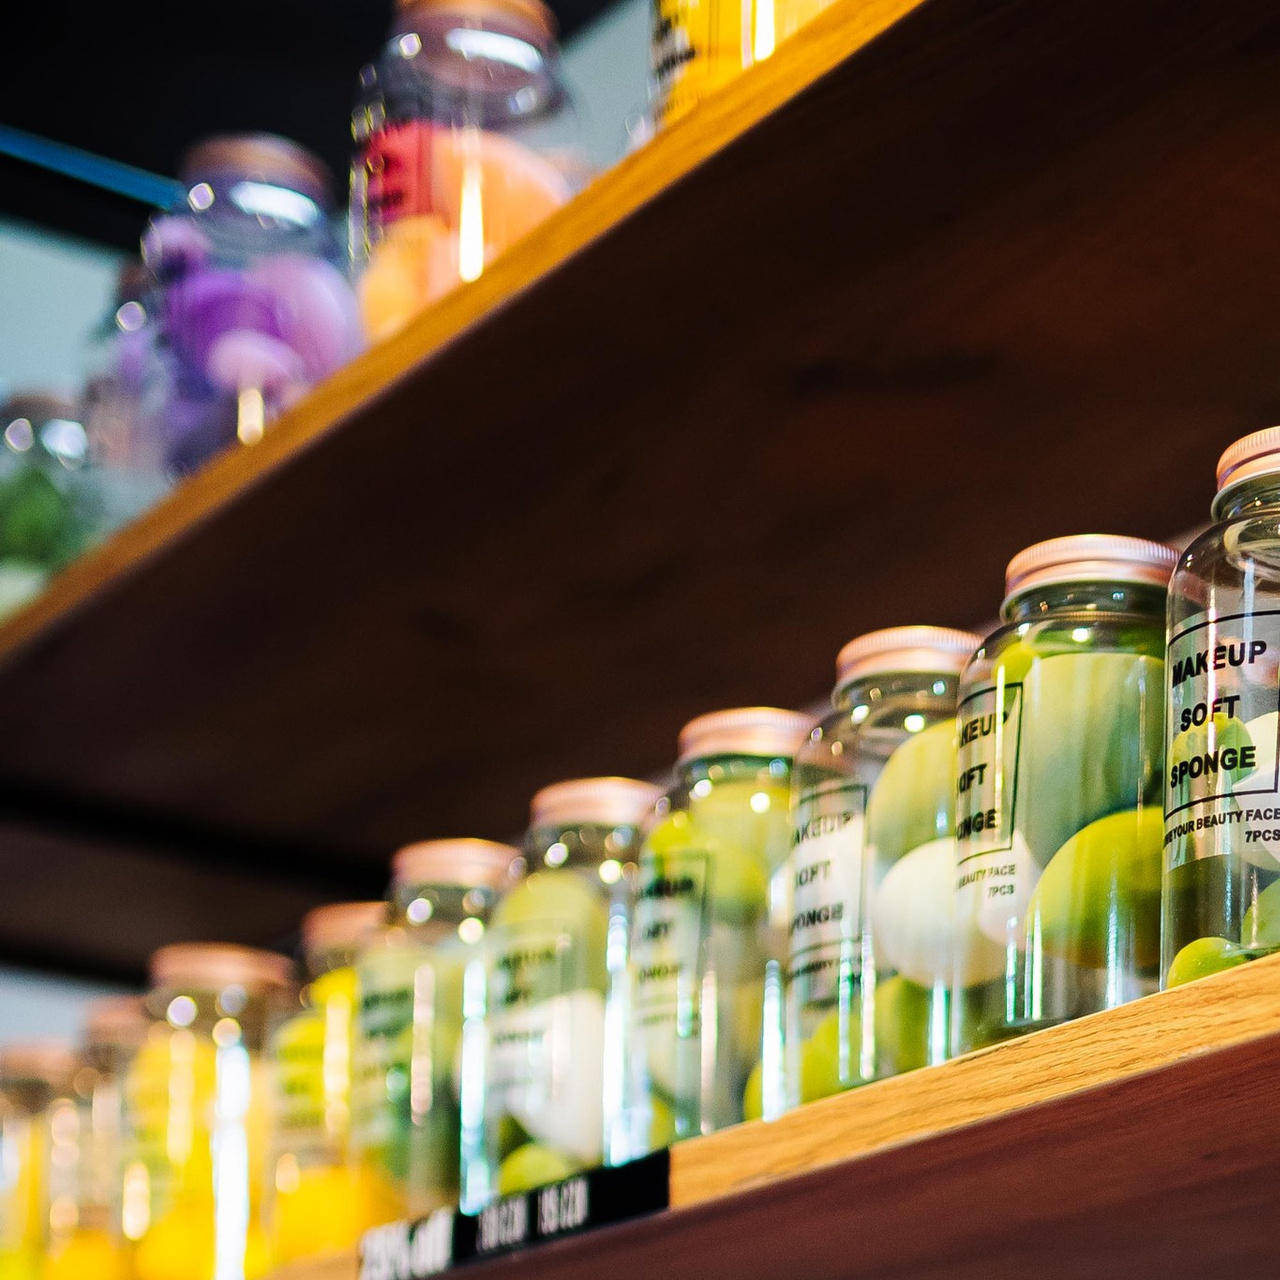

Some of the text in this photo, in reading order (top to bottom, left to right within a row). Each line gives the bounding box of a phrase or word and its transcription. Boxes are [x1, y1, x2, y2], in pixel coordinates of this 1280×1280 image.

[1172, 639, 1268, 688] MAKEUP
[1180, 694, 1240, 733] SOFT
[1170, 745, 1257, 789] SPONGE
[1172, 817, 1194, 840] YOUR
[1196, 809, 1243, 831] BEAUTY
